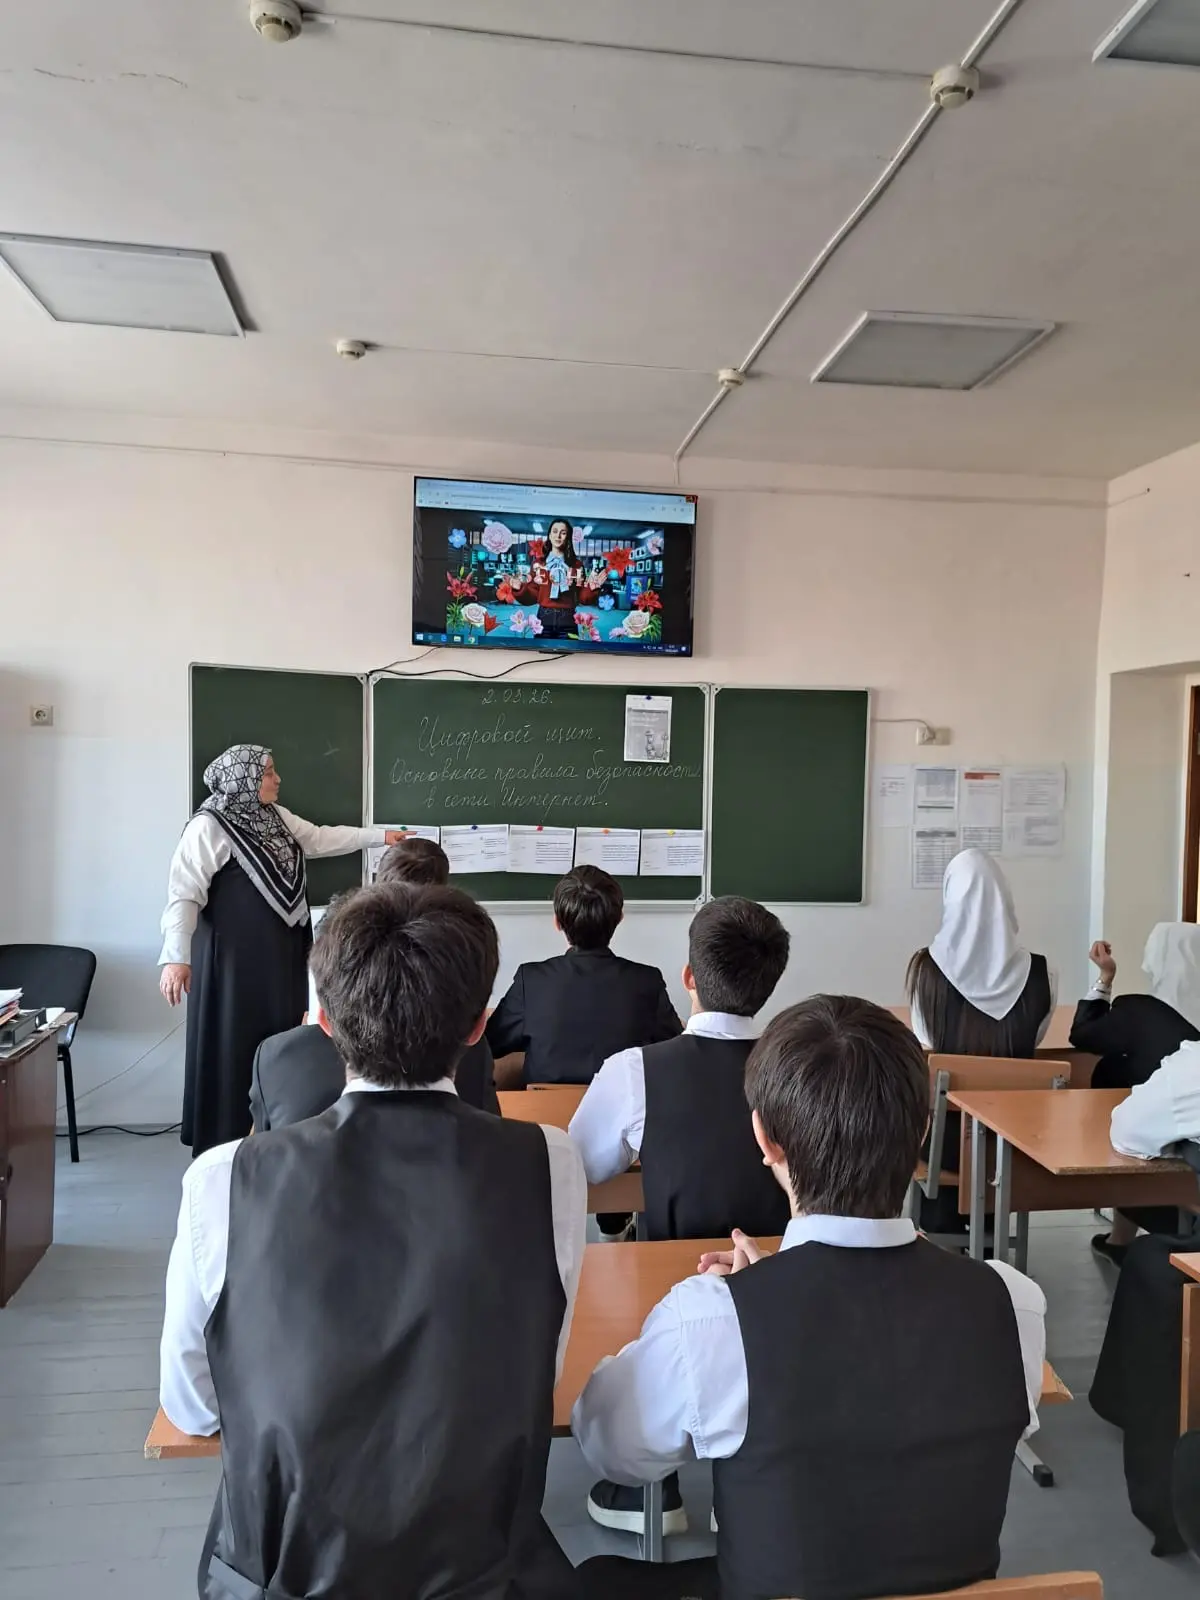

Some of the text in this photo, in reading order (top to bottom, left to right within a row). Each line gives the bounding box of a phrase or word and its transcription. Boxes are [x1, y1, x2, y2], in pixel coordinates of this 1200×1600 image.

[418, 712, 601, 761] Цифровой щит.
[390, 757, 488, 784] Основные
[494, 752, 578, 793] правила
[424, 785, 608, 822] в сети Интернет.
